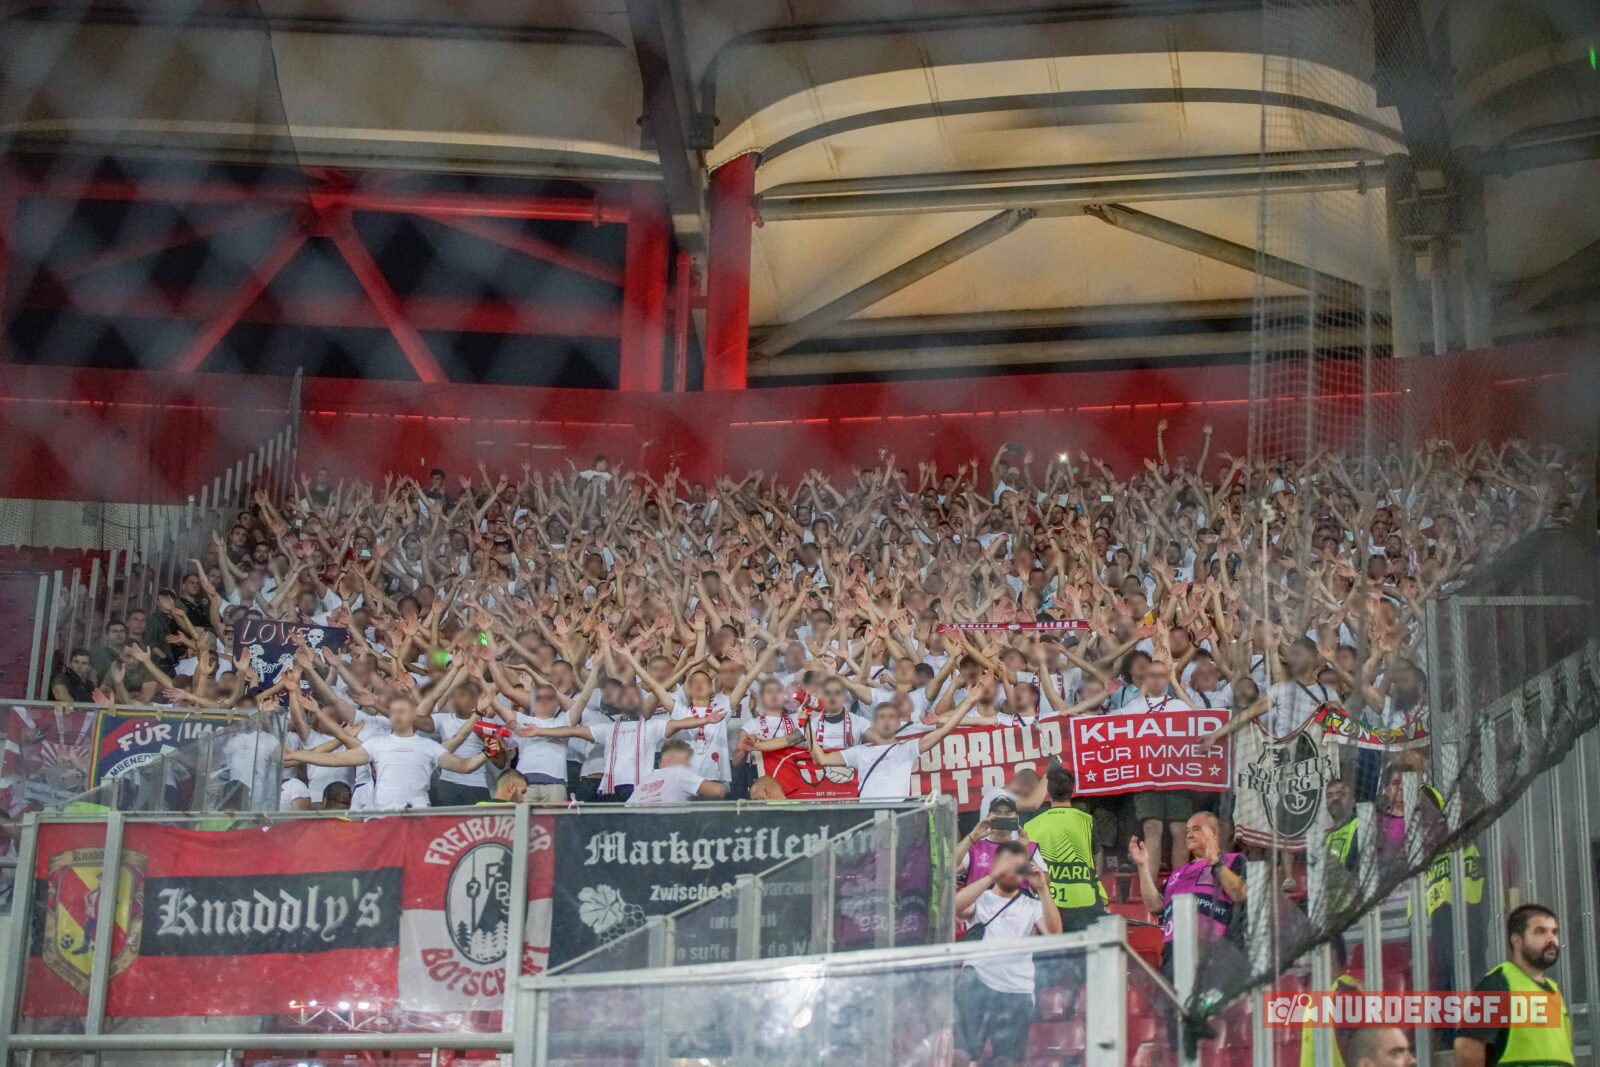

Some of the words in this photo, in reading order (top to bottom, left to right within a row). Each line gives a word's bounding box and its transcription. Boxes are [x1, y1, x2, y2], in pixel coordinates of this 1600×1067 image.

[117, 722, 172, 752] FÜR
[1080, 716, 1223, 744] KHALID
[910, 720, 1063, 773] ORRILLO
[1081, 745, 1132, 765] FÜR
[1140, 743, 1224, 759] IMMER
[1103, 765, 1140, 783] BEI
[1147, 762, 1203, 778] UNS
[1048, 865, 1091, 880] WARD
[157, 877, 383, 942] Knaddly's
